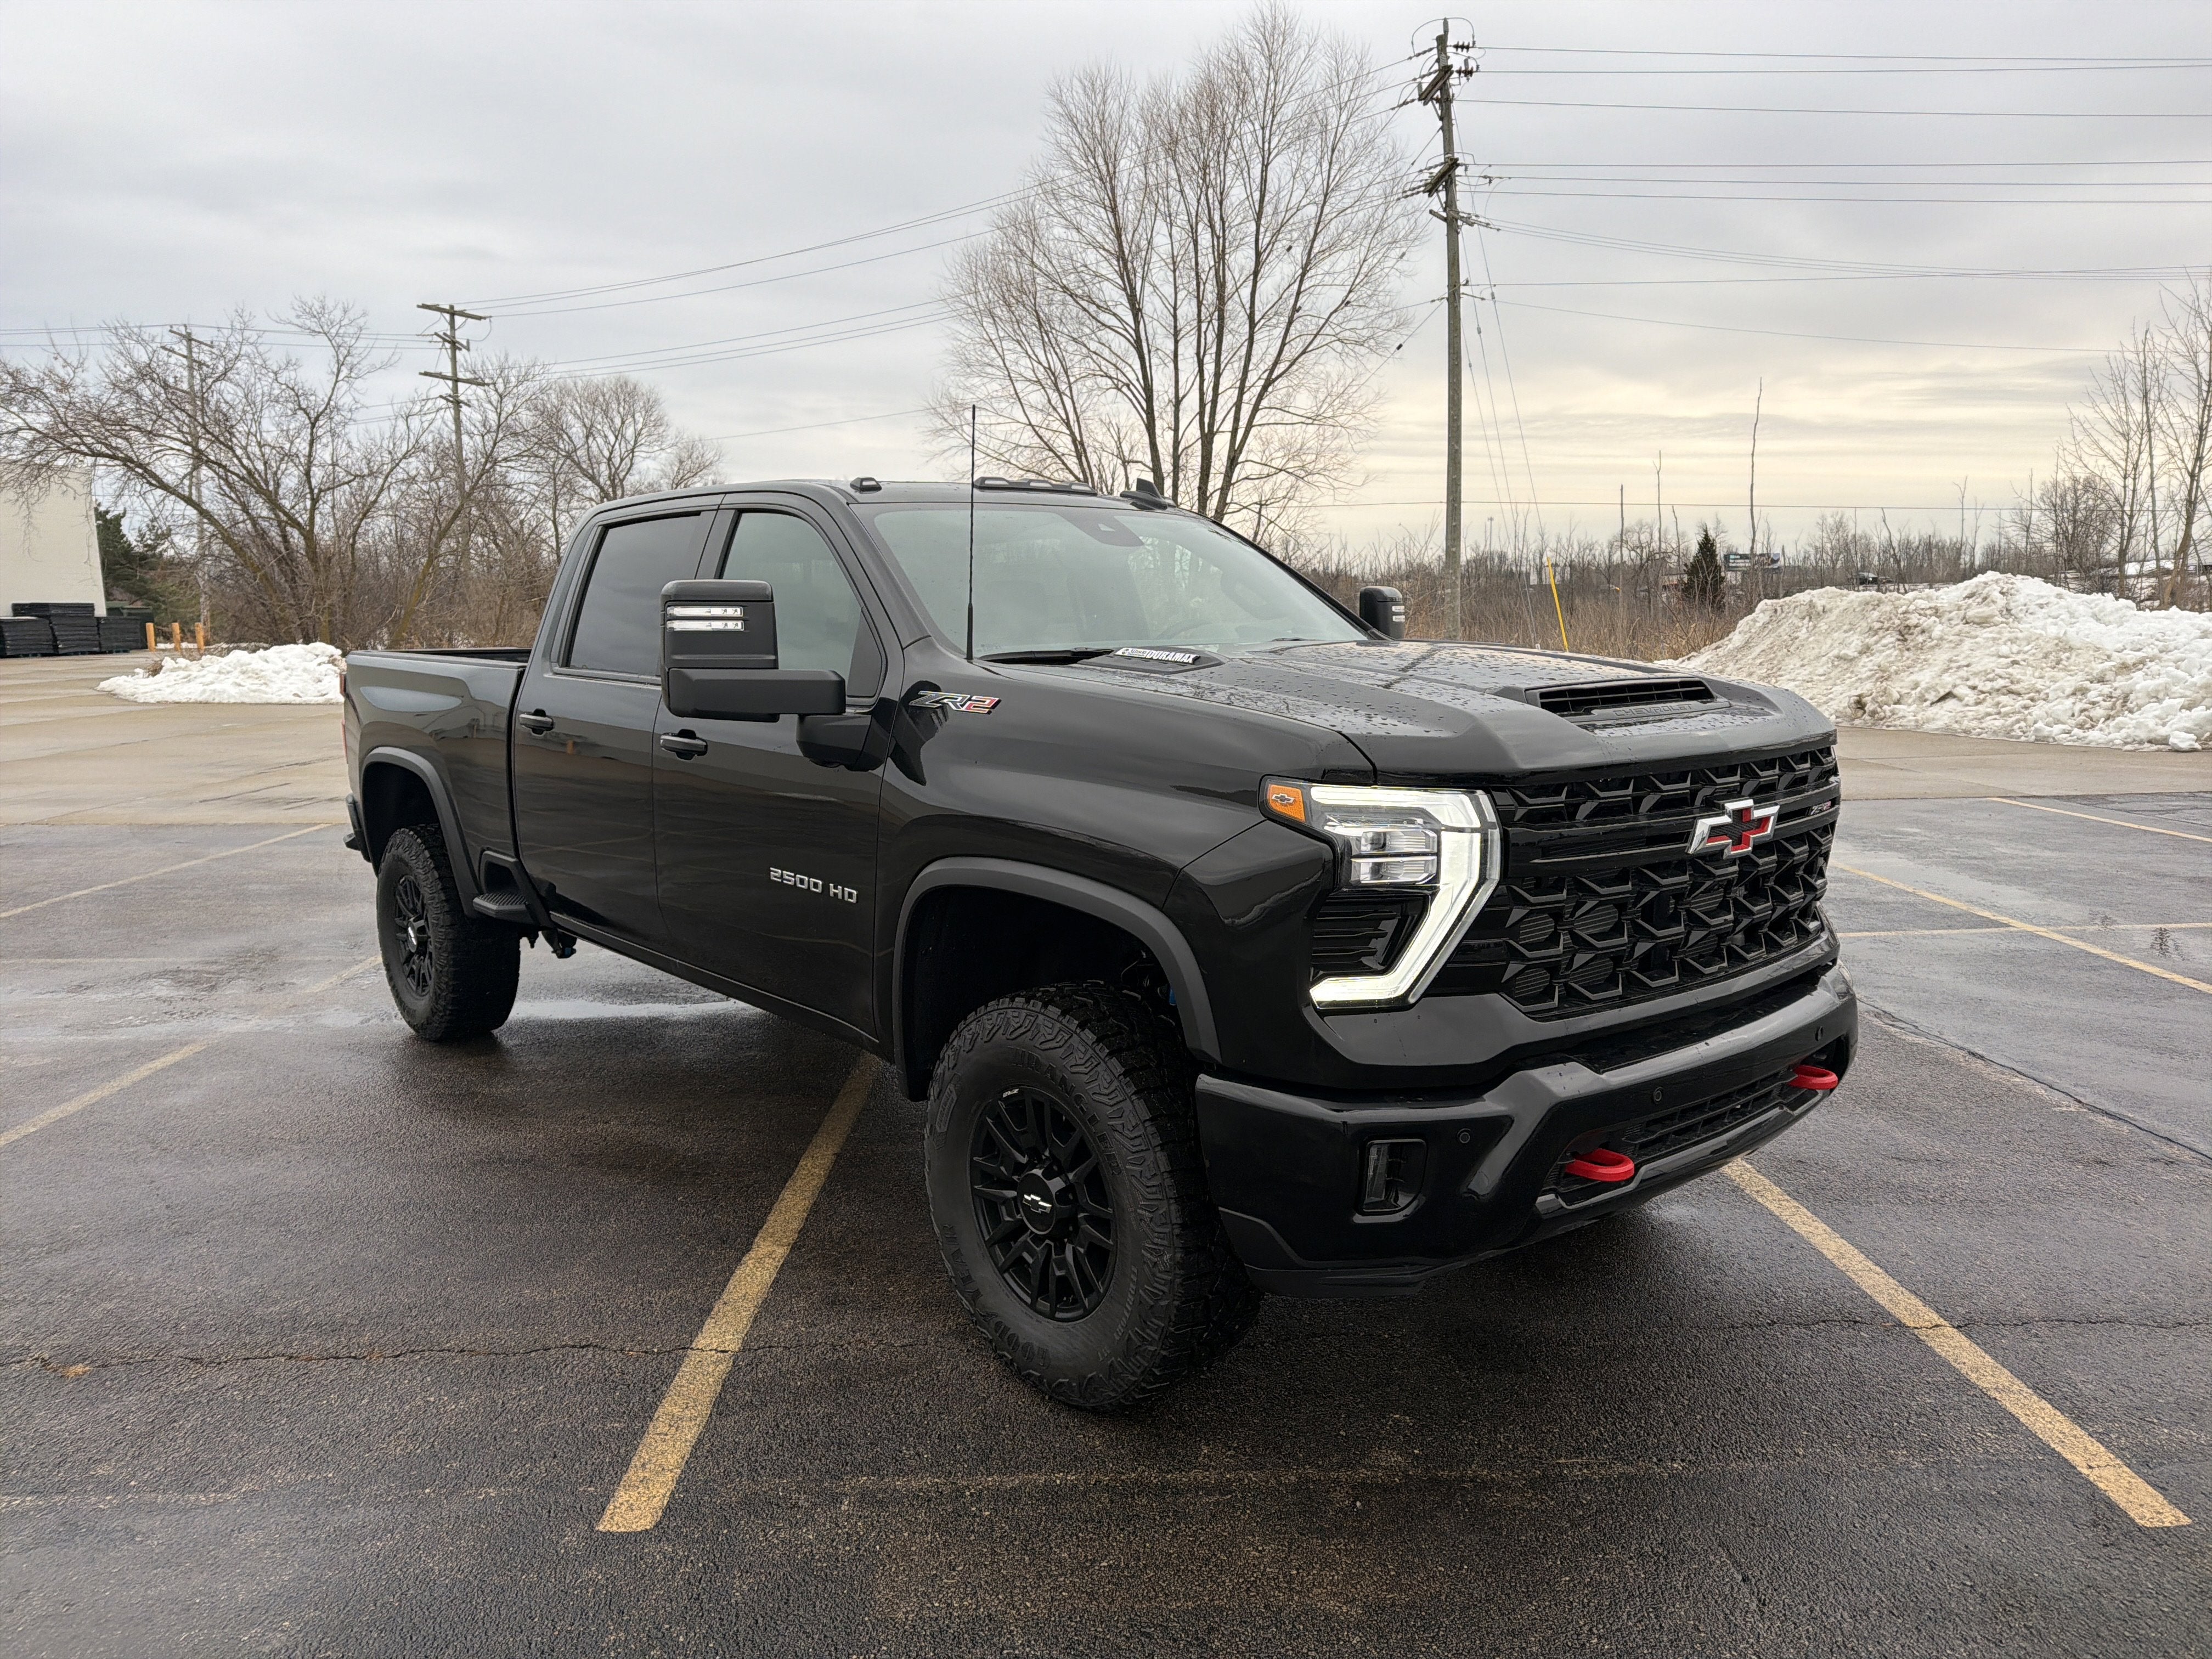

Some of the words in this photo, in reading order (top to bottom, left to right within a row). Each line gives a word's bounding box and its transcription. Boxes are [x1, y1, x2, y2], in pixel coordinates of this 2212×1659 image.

[1147, 650, 1200, 663] DURAMAX
[909, 691, 1001, 714] ZR2
[1613, 703, 1691, 716] CHEVROLET
[770, 867, 822, 893] 2500
[829, 883, 857, 903] HD
[1007, 1045, 1122, 1175] WRANGLER
[942, 1224, 1051, 1370] GOODYEAR
